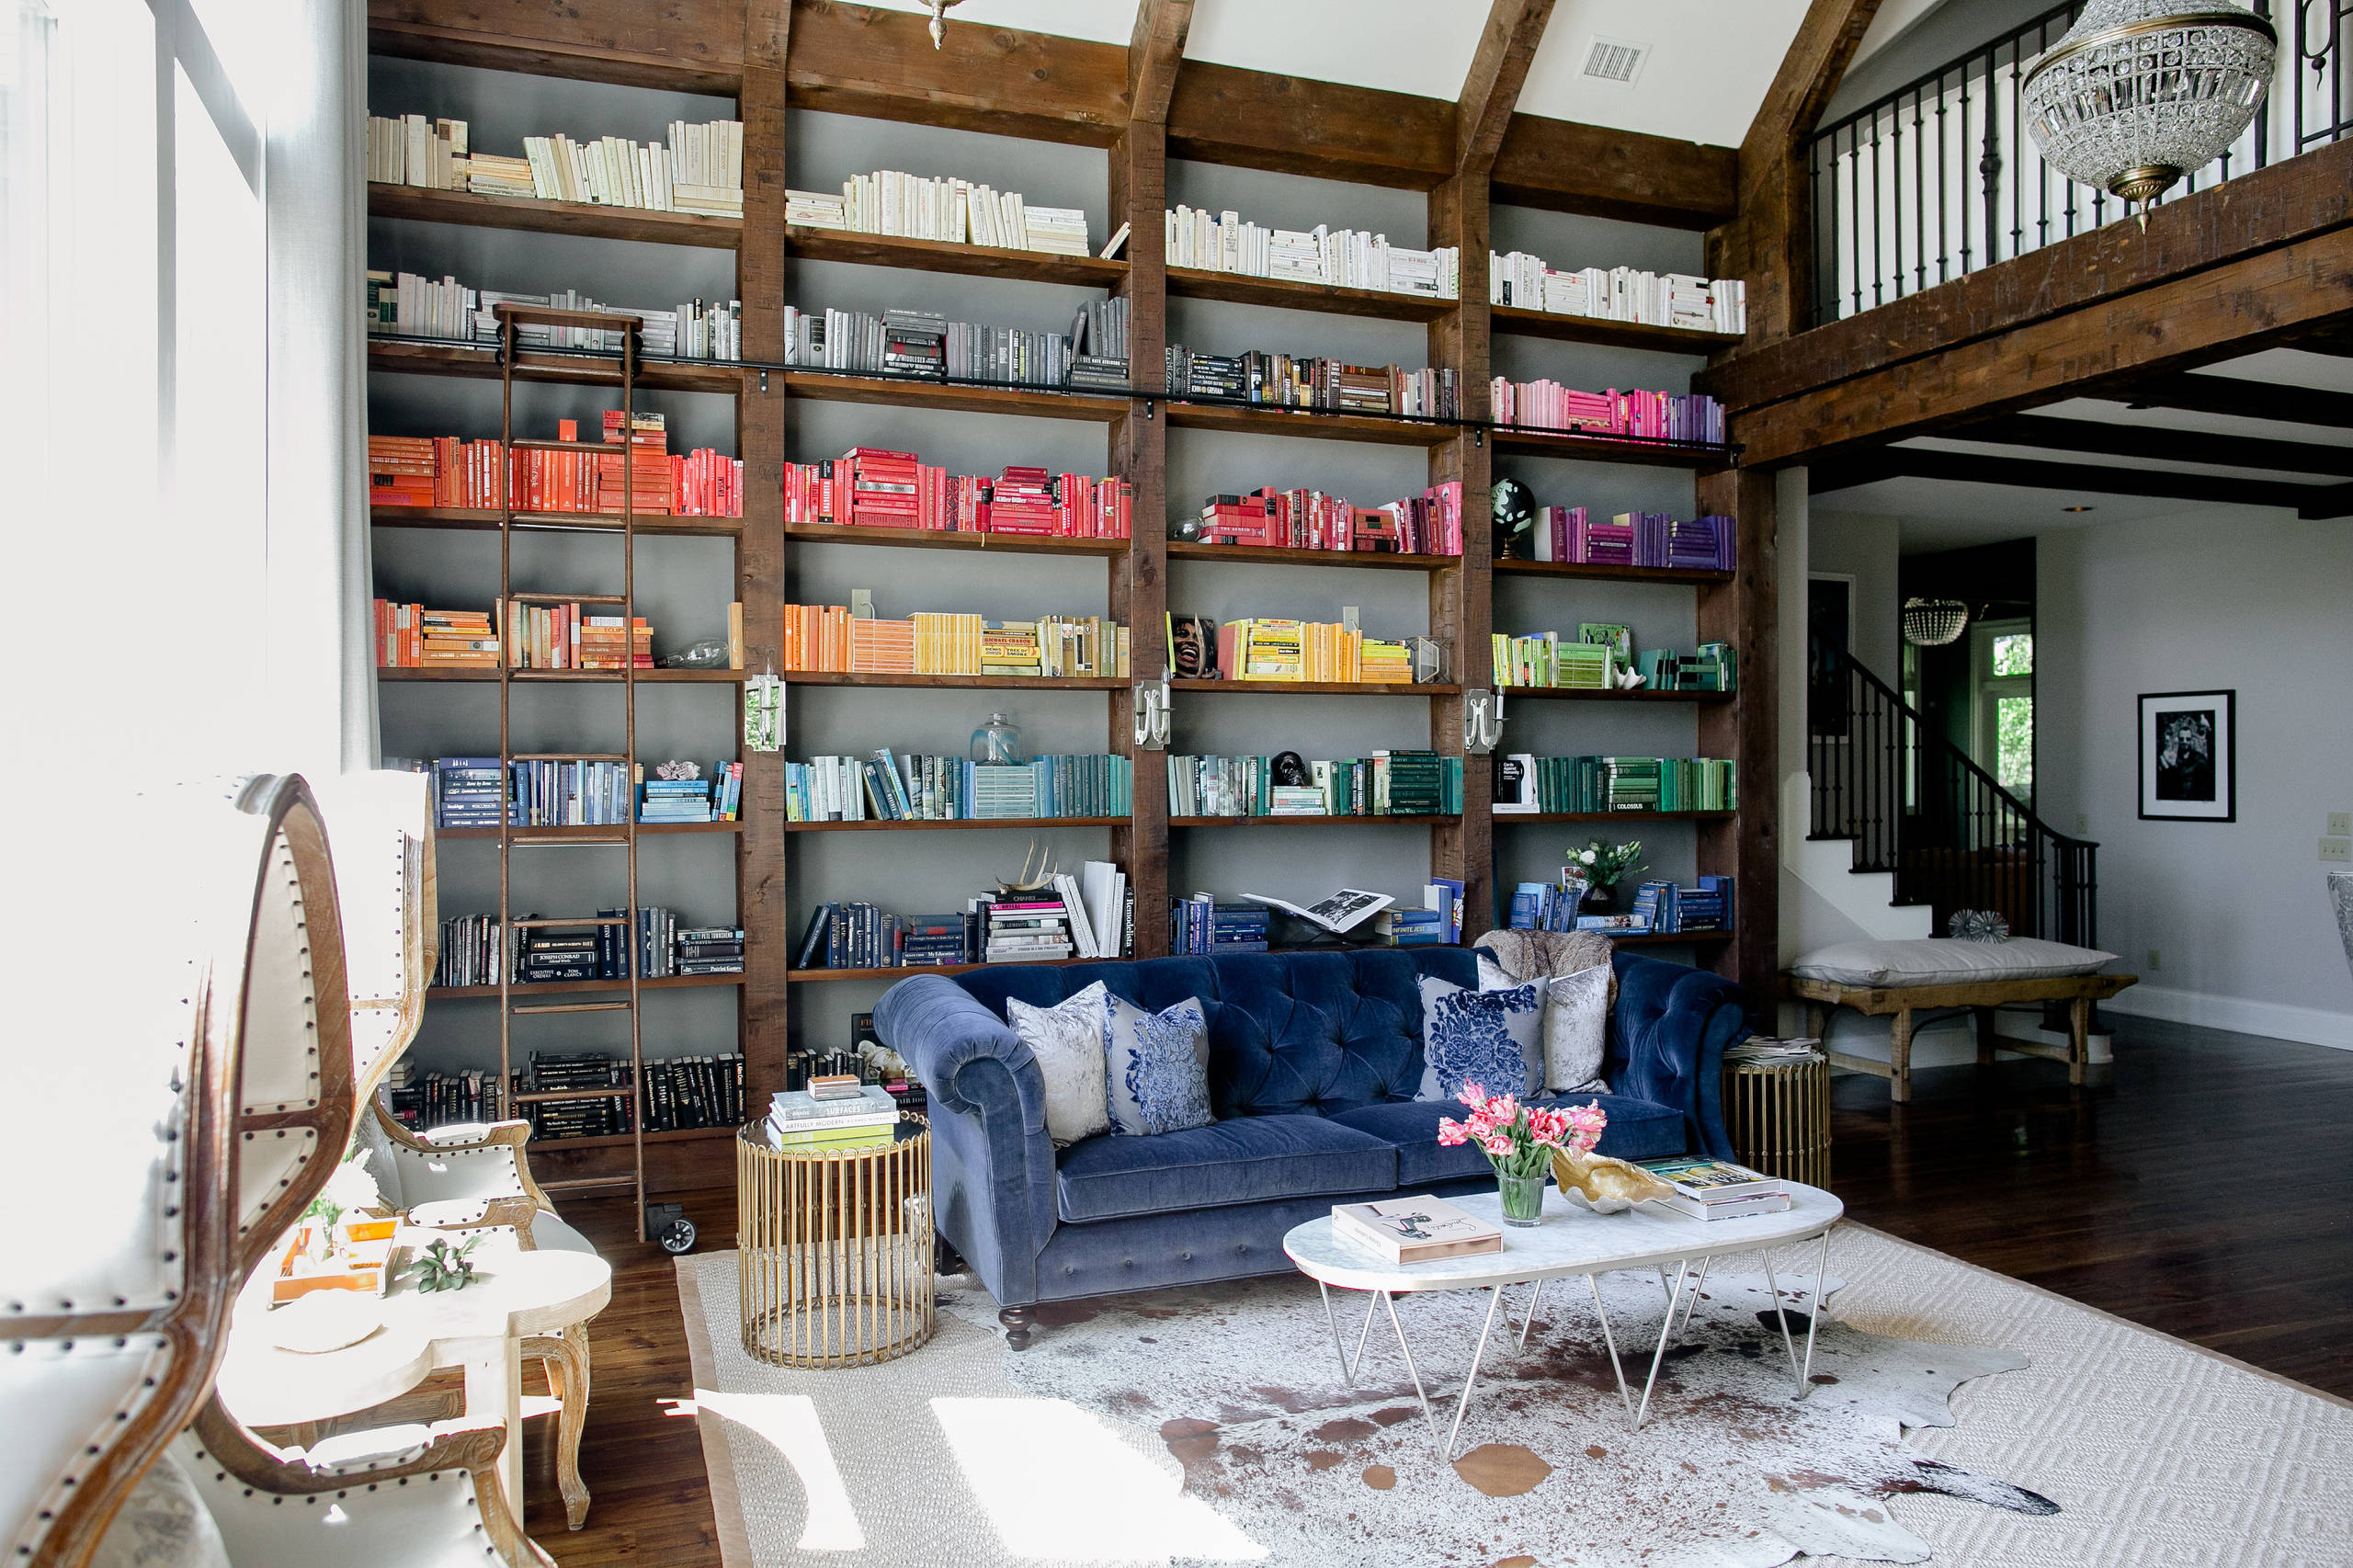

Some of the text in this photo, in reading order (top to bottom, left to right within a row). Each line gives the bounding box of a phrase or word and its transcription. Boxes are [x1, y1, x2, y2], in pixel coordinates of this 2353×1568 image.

[1126, 899, 1134, 948] Remodelista
[711, 931, 733, 939] TOWNSHEND
[826, 1105, 861, 1115] SURFACES
[786, 1119, 814, 1130] ARTFULLY
[816, 1118, 845, 1126] MODERN
